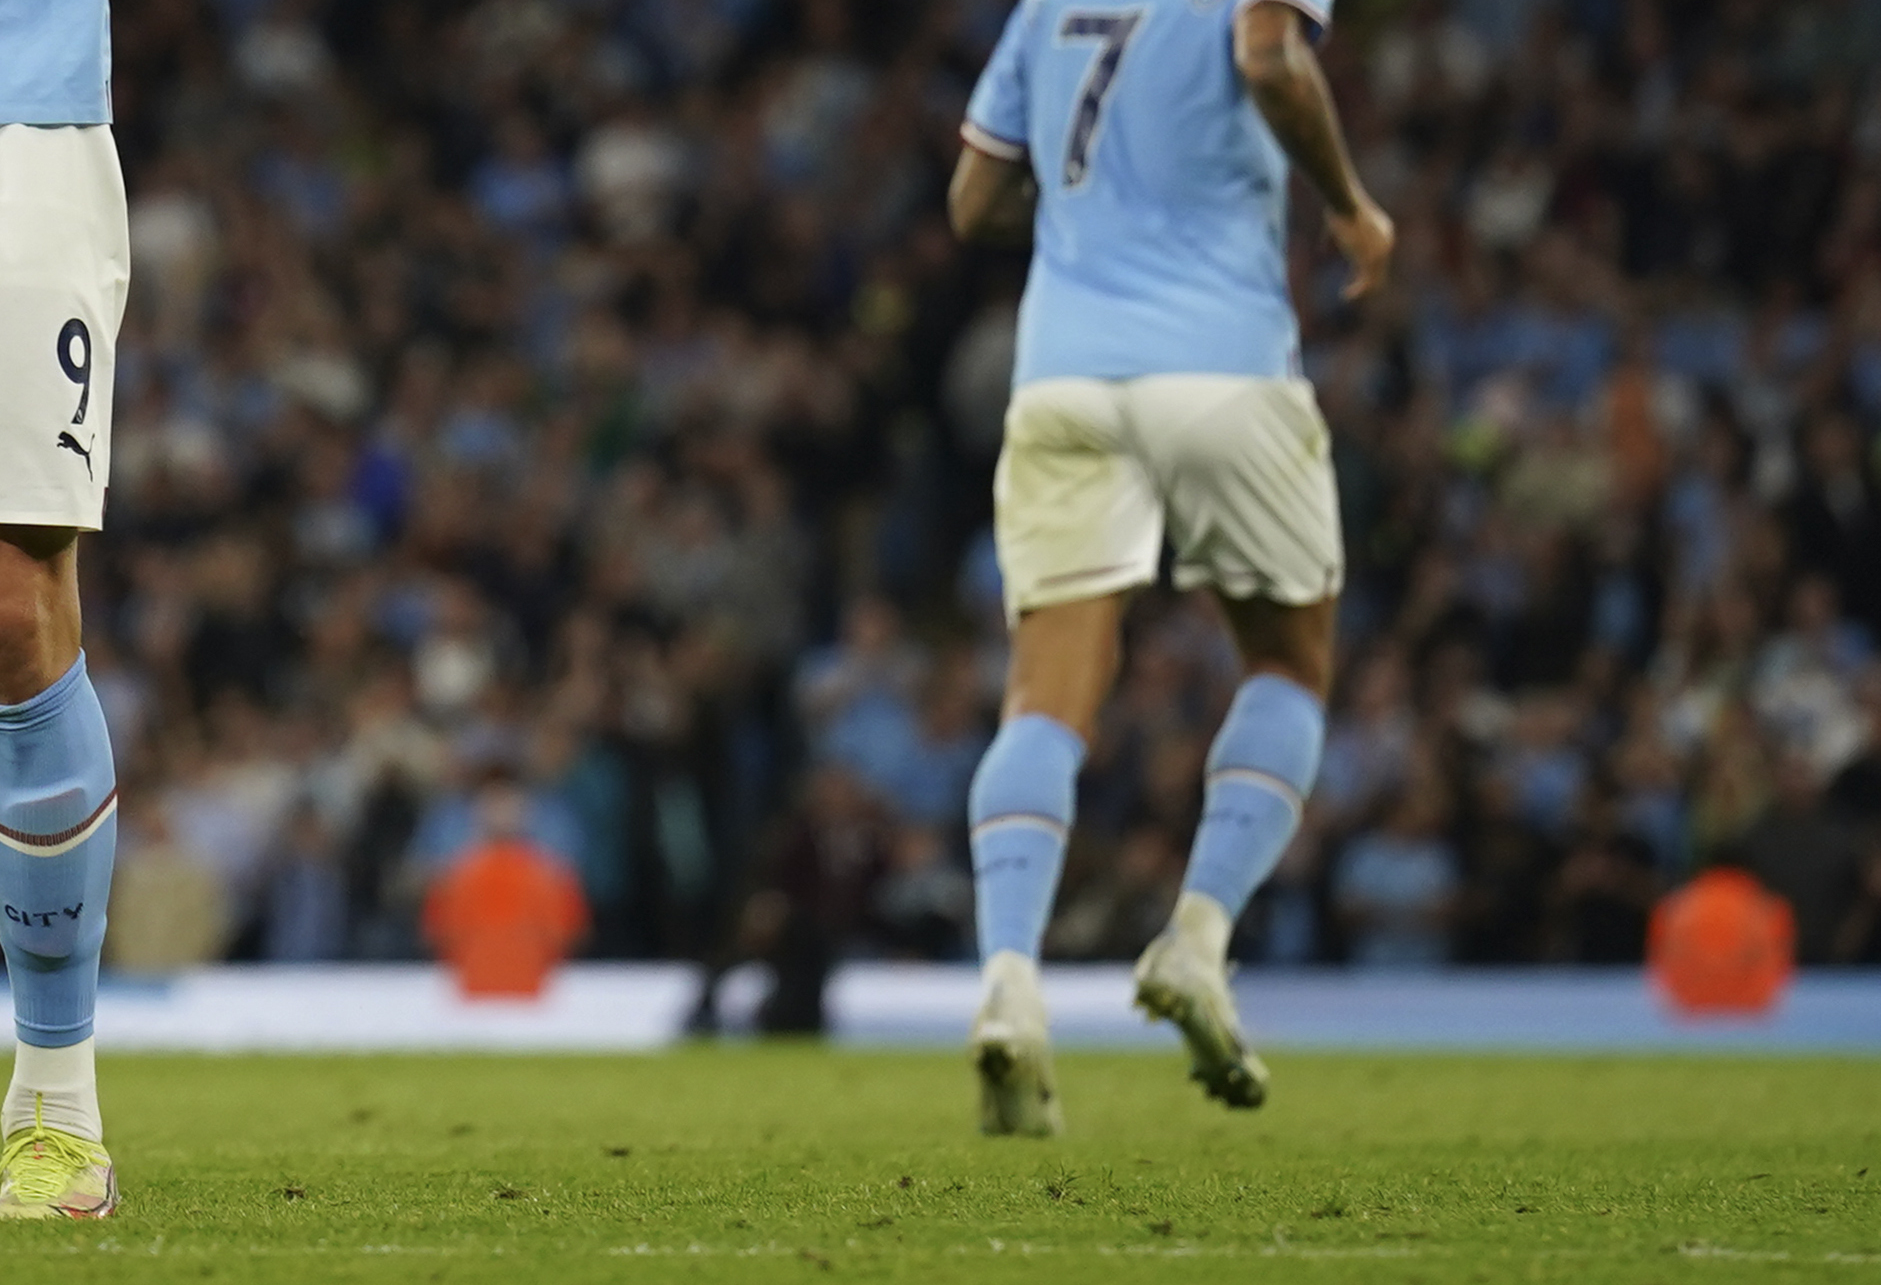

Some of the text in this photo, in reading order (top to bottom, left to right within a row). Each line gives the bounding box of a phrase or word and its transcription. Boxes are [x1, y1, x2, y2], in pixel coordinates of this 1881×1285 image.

[1055, 2, 1152, 191] 7
[57, 318, 91, 425] 9
[4, 902, 83, 927] CITY
